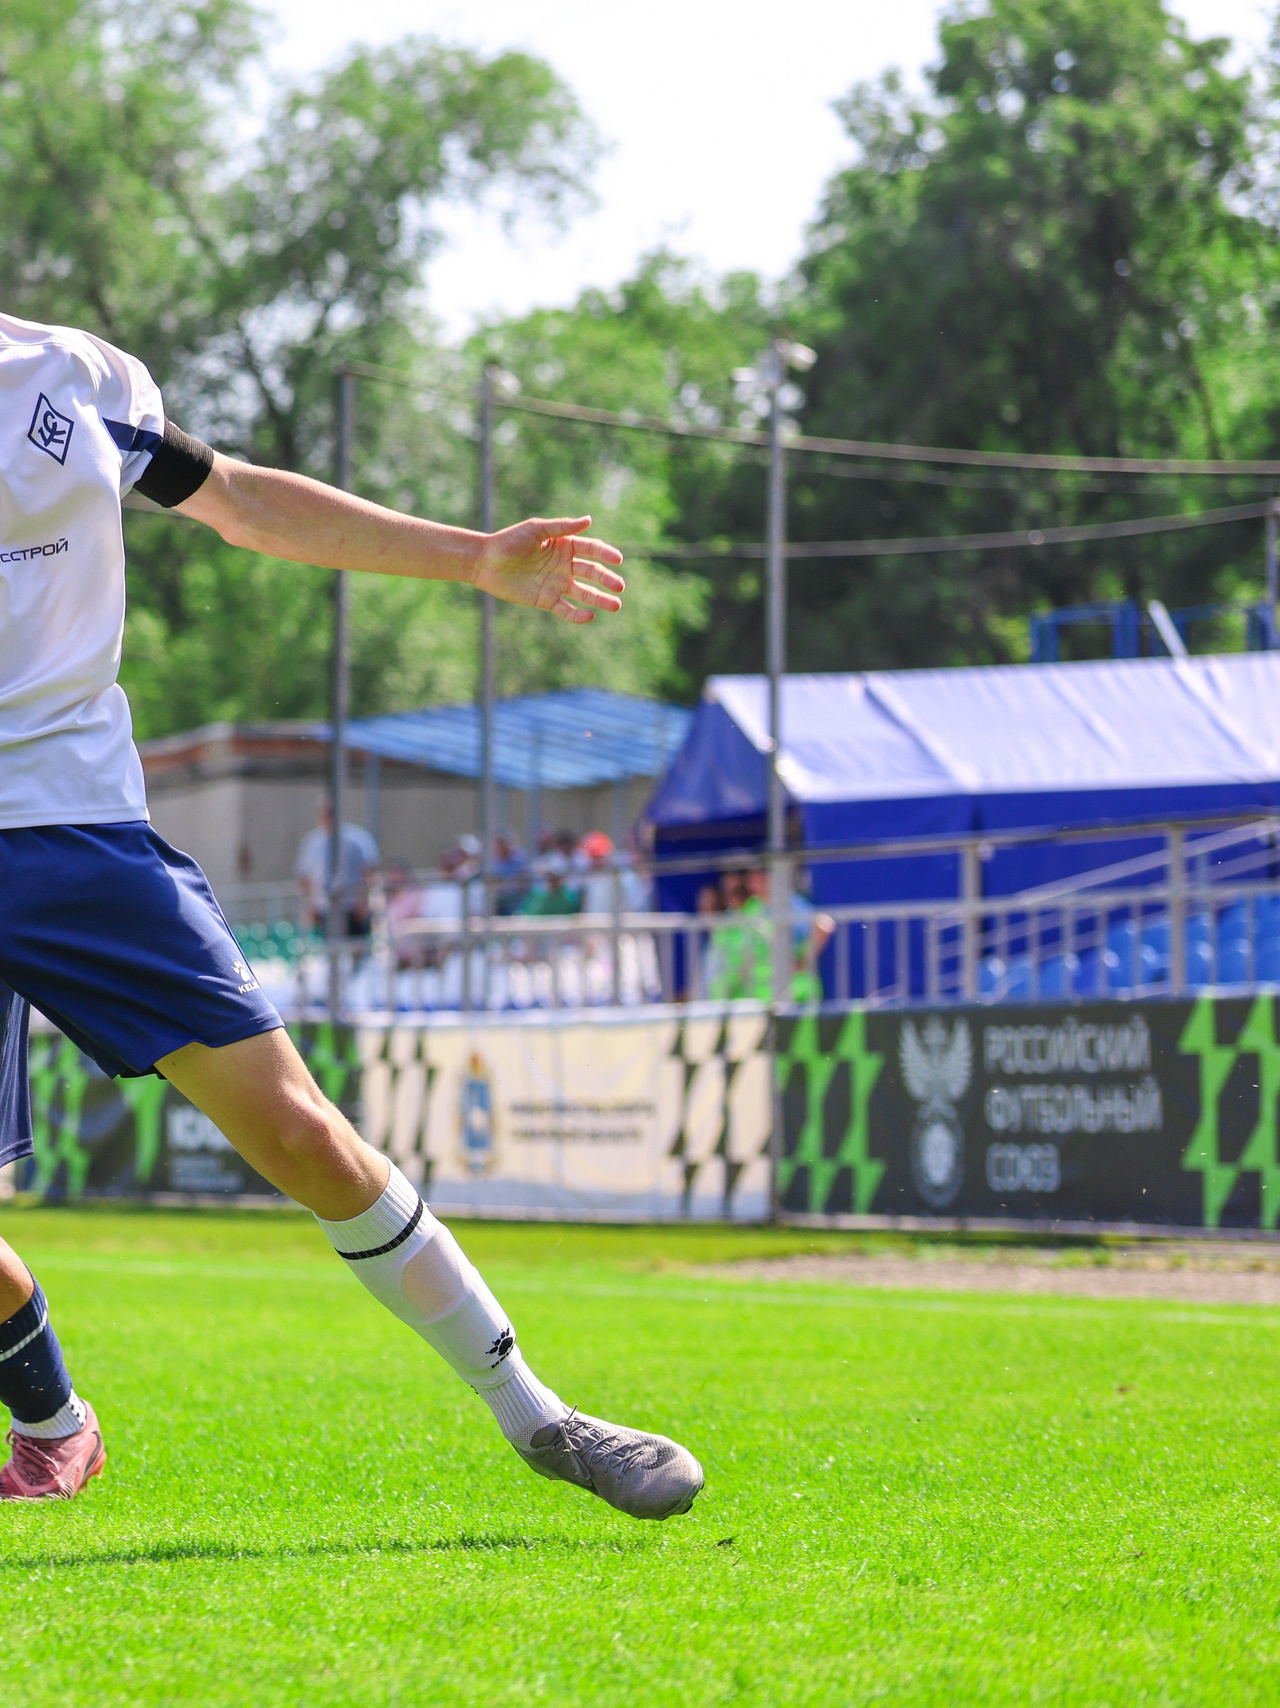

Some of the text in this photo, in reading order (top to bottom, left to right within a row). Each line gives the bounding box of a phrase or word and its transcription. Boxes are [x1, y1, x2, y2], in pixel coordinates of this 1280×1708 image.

[984, 1016, 1152, 1073] РОССИЙСКИЙ
[985, 1076, 1162, 1133] ФУТБОЛЬНЫЙ
[987, 1143, 1060, 1191] СОЮЗ
